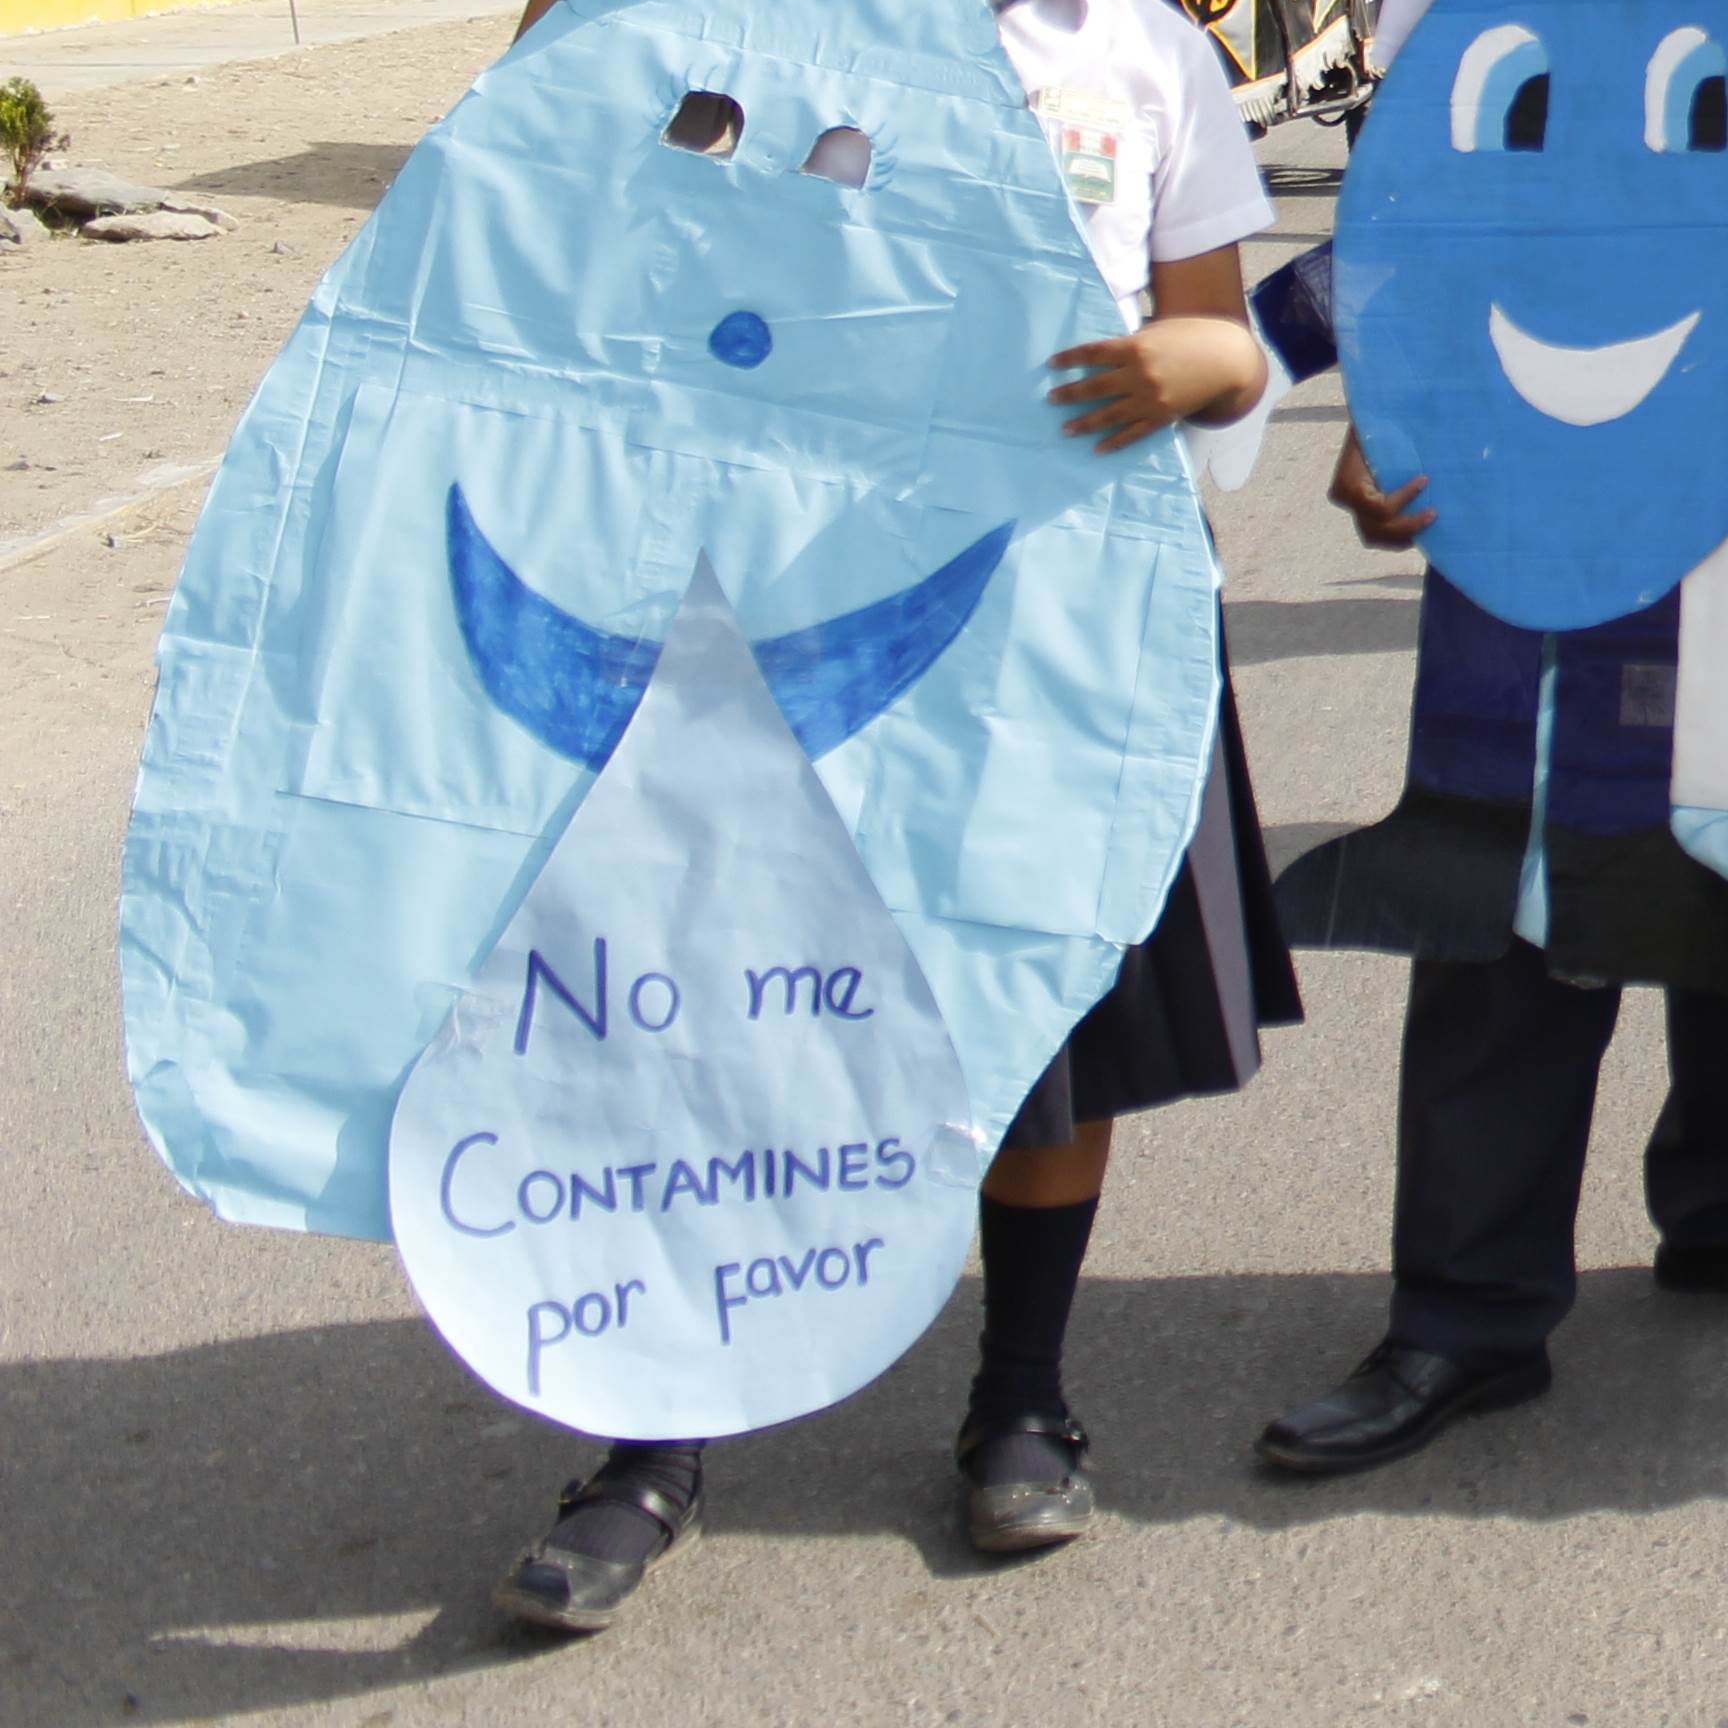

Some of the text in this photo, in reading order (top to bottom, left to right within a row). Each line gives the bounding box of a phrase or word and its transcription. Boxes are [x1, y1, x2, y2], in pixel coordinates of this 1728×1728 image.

[513, 936, 877, 1056] No me
[440, 1130, 916, 1238] CONTAMINES
[526, 1277, 648, 1397] por
